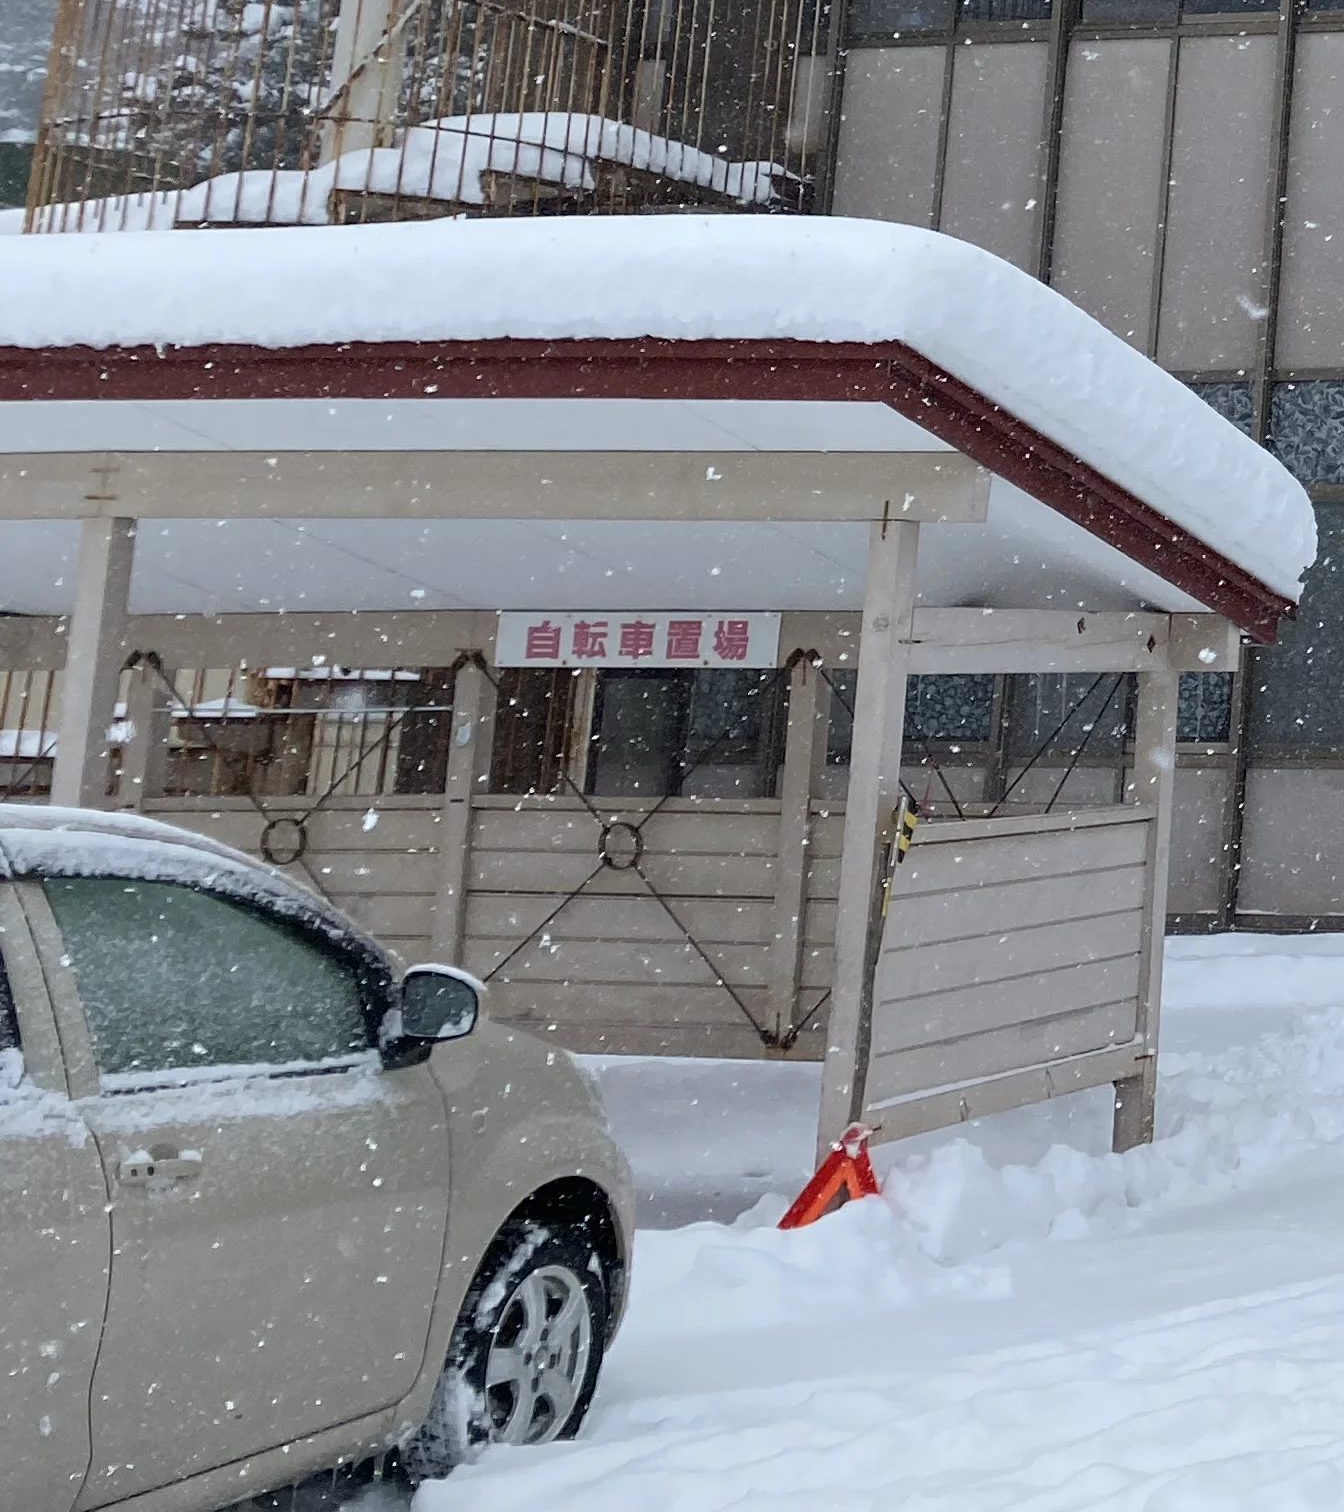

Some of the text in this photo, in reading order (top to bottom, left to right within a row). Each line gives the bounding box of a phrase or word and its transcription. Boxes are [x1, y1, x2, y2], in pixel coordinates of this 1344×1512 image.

[525, 619, 749, 661] 自転車置場
